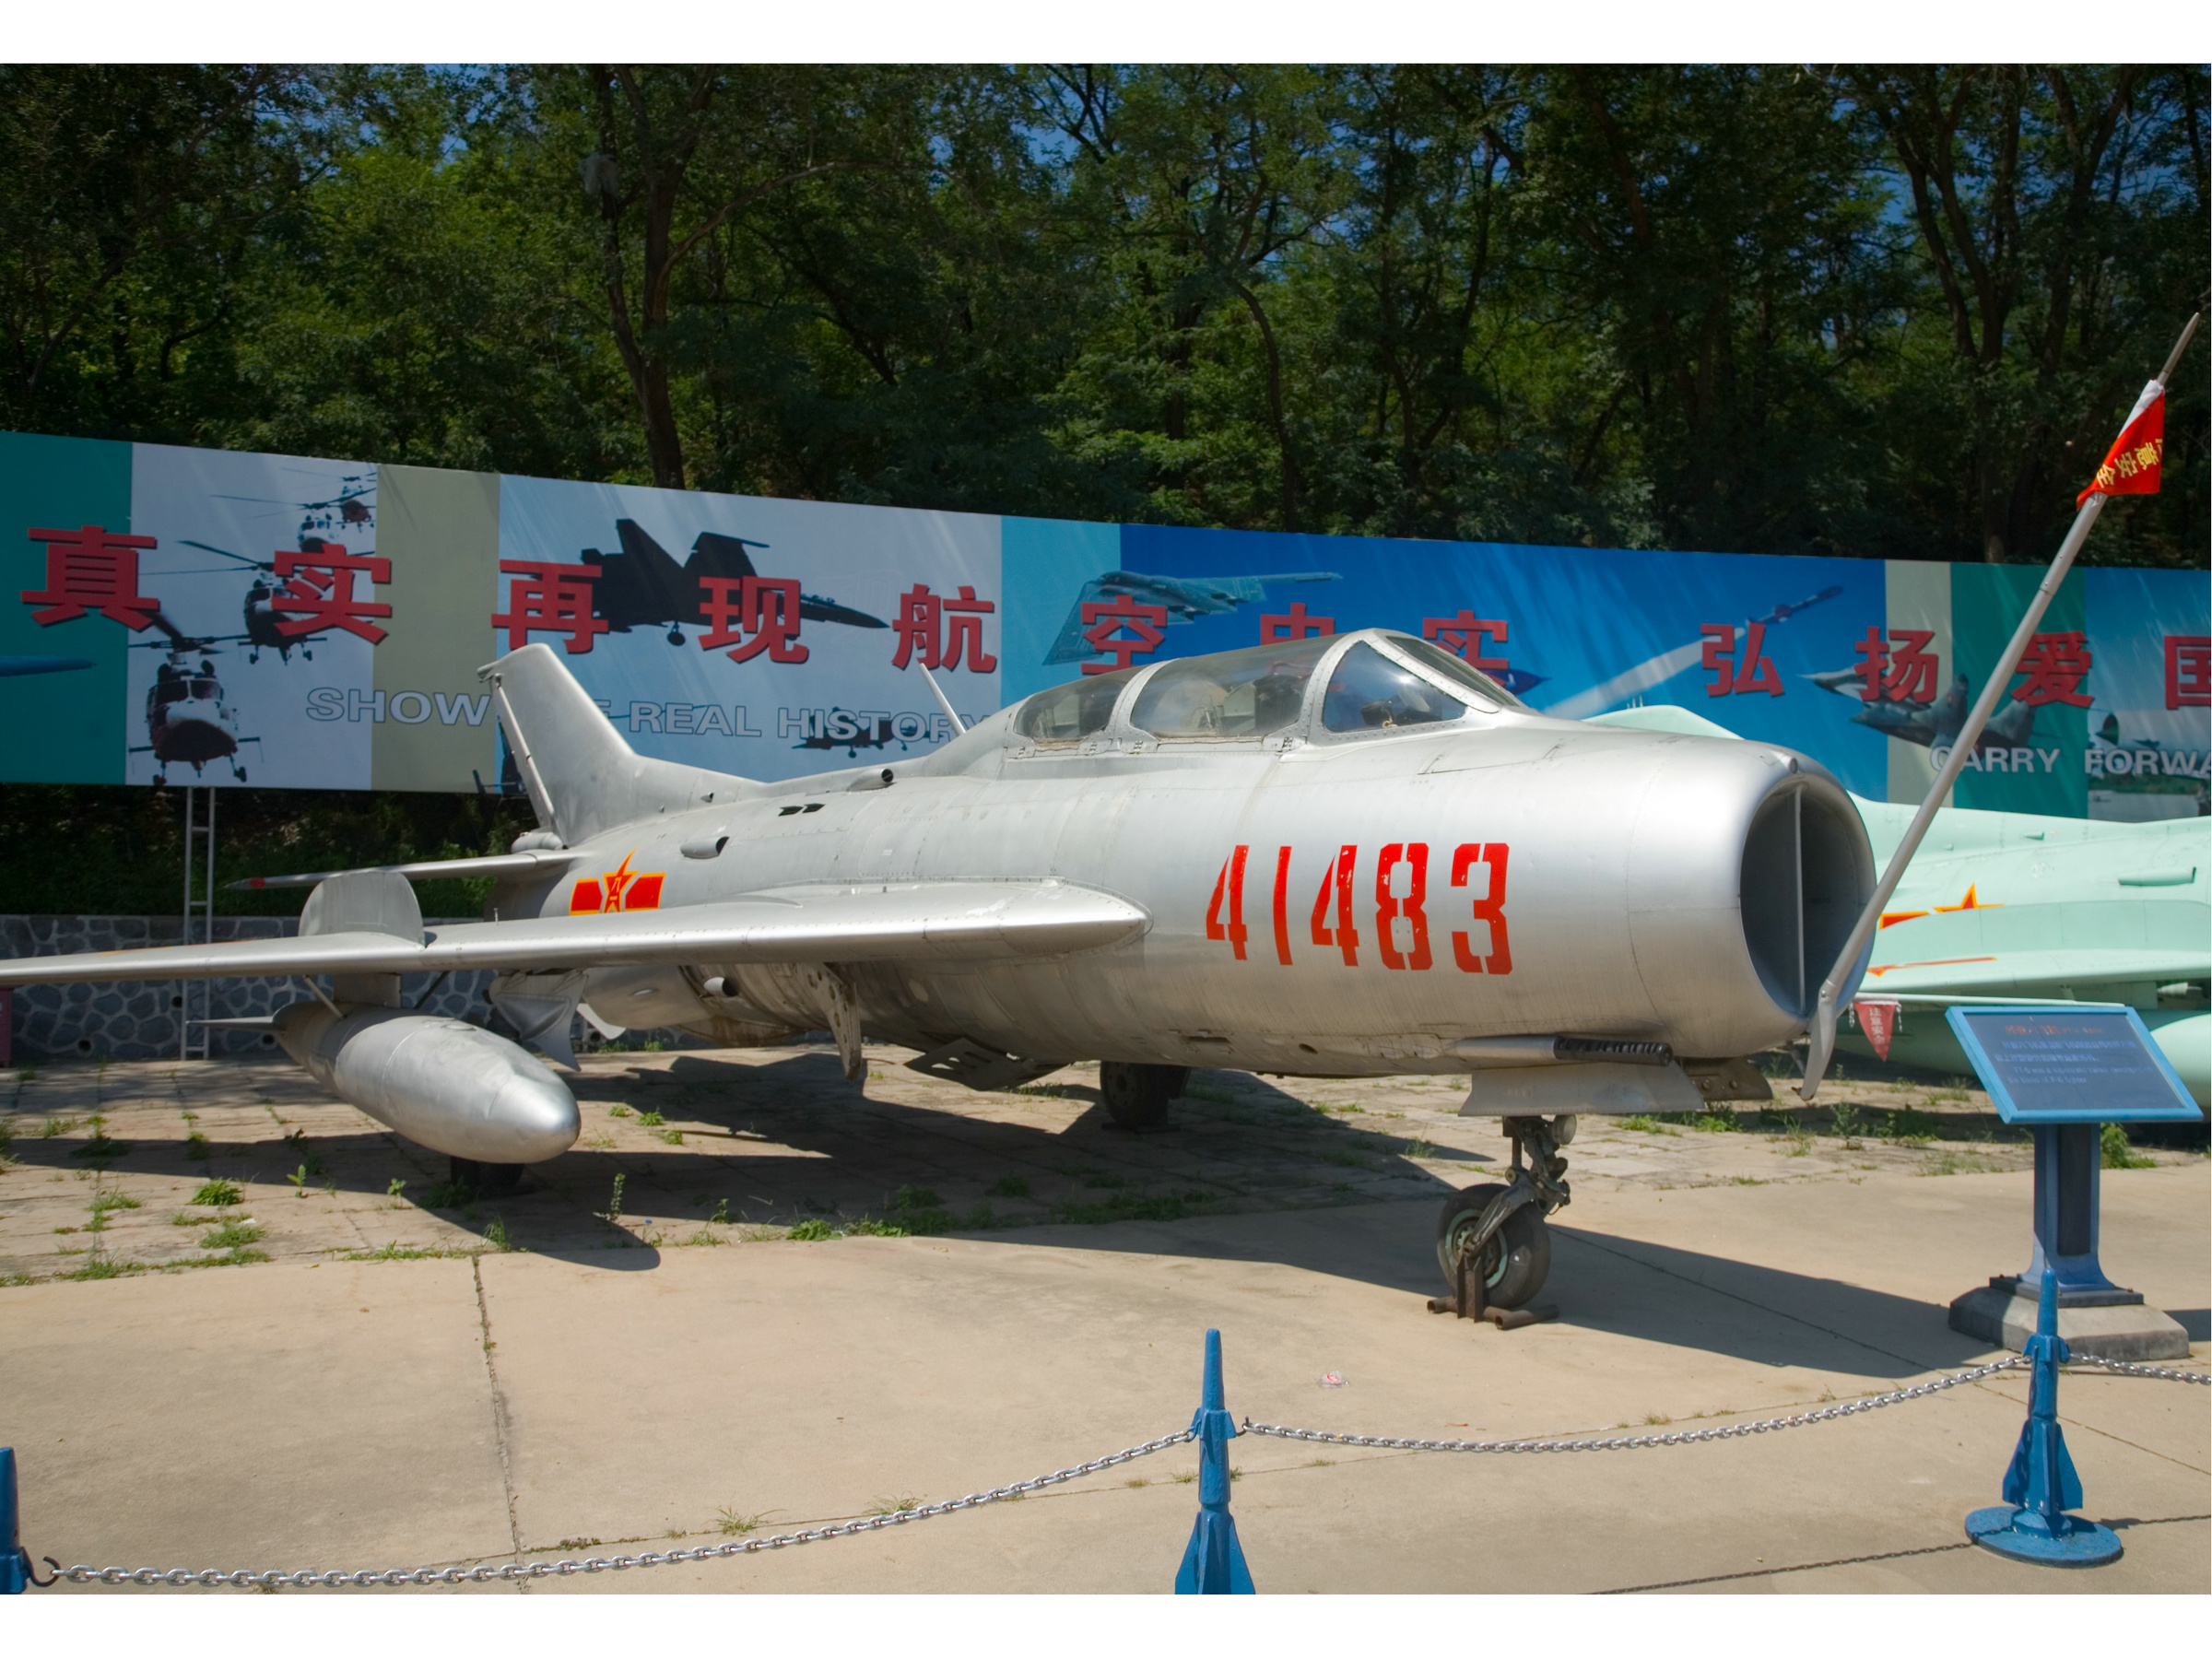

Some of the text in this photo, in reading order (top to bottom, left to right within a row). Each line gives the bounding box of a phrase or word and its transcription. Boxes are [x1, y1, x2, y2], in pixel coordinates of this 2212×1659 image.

[1700, 622, 2210, 710] 弘扬爱国
[305, 687, 491, 726] SHOW
[629, 700, 762, 737] REAL
[1931, 745, 2061, 773] CARRY
[1206, 842, 1512, 975] 41483
